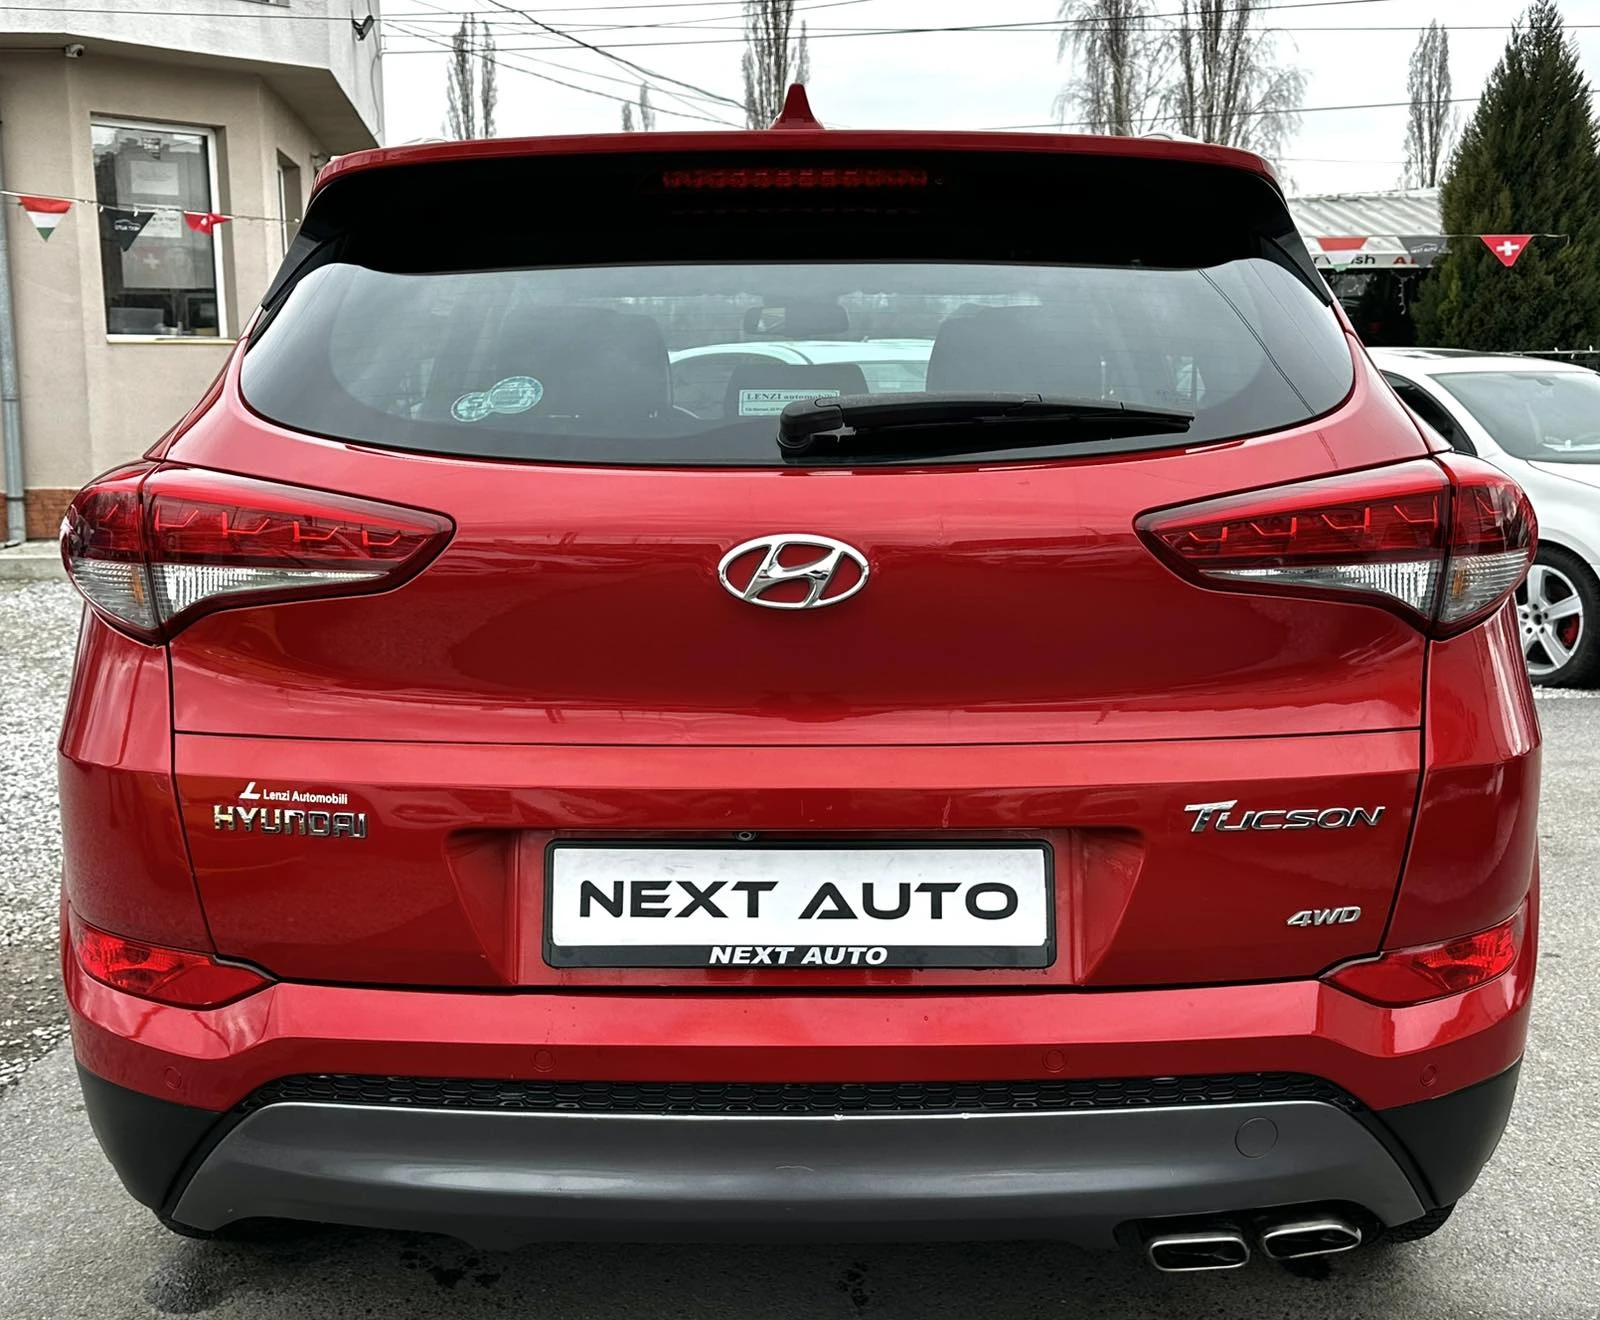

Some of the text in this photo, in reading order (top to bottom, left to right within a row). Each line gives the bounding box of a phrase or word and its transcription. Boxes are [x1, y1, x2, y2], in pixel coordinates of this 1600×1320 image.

[263, 789, 290, 801] Lenzi
[292, 790, 348, 804] Automobili
[214, 805, 367, 838] HYUNDAI
[580, 880, 1018, 920] NEXT AUTO
[1287, 906, 1361, 926] 4WD
[709, 947, 888, 965] NEXT AUTO
